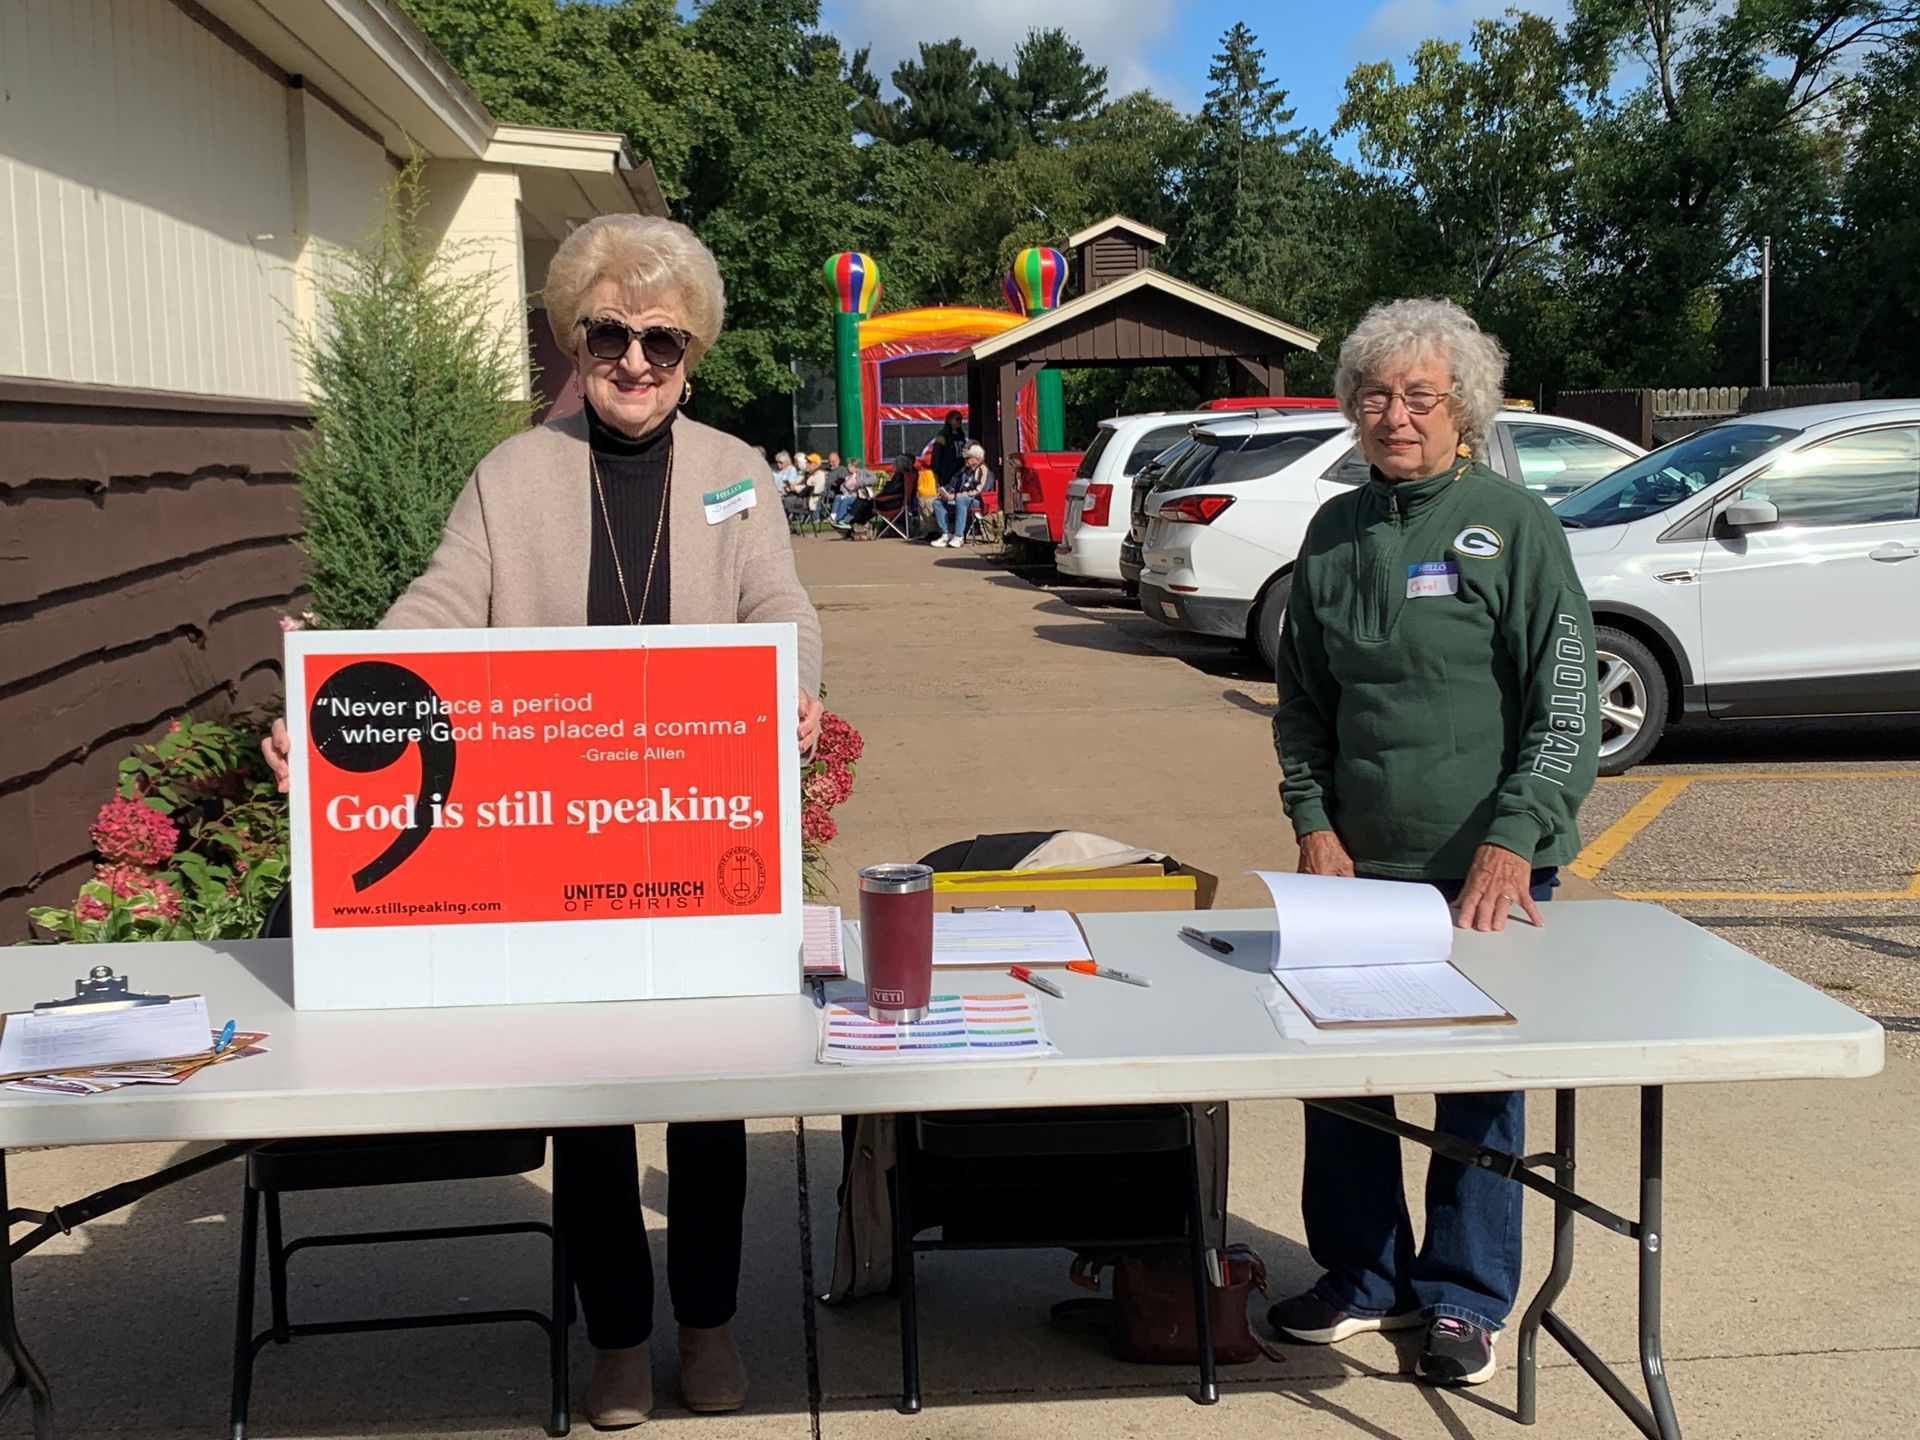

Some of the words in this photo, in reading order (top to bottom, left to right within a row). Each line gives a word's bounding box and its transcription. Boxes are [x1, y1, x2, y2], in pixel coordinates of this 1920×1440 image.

[1451, 524, 1504, 560] G
[415, 696, 481, 719] place
[490, 699, 504, 713] a
[513, 693, 593, 717] period
[1530, 613, 1587, 786] FOOTBAL
[342, 725, 422, 744] where
[430, 721, 483, 742] God
[492, 721, 536, 740] has
[544, 719, 624, 743] placed
[633, 723, 647, 737] a
[654, 720, 747, 737] comma
[644, 747, 685, 760] Allen
[326, 795, 418, 832] God
[430, 793, 464, 829] is
[477, 791, 554, 828] still
[566, 786, 764, 834] speaking,
[564, 884, 628, 900] UNITED
[633, 881, 704, 898] CHURCH
[333, 901, 501, 916] www.stillspeaking.com
[564, 900, 594, 912] OF
[610, 897, 704, 911] CHRIST
[874, 991, 901, 1002] YETI
